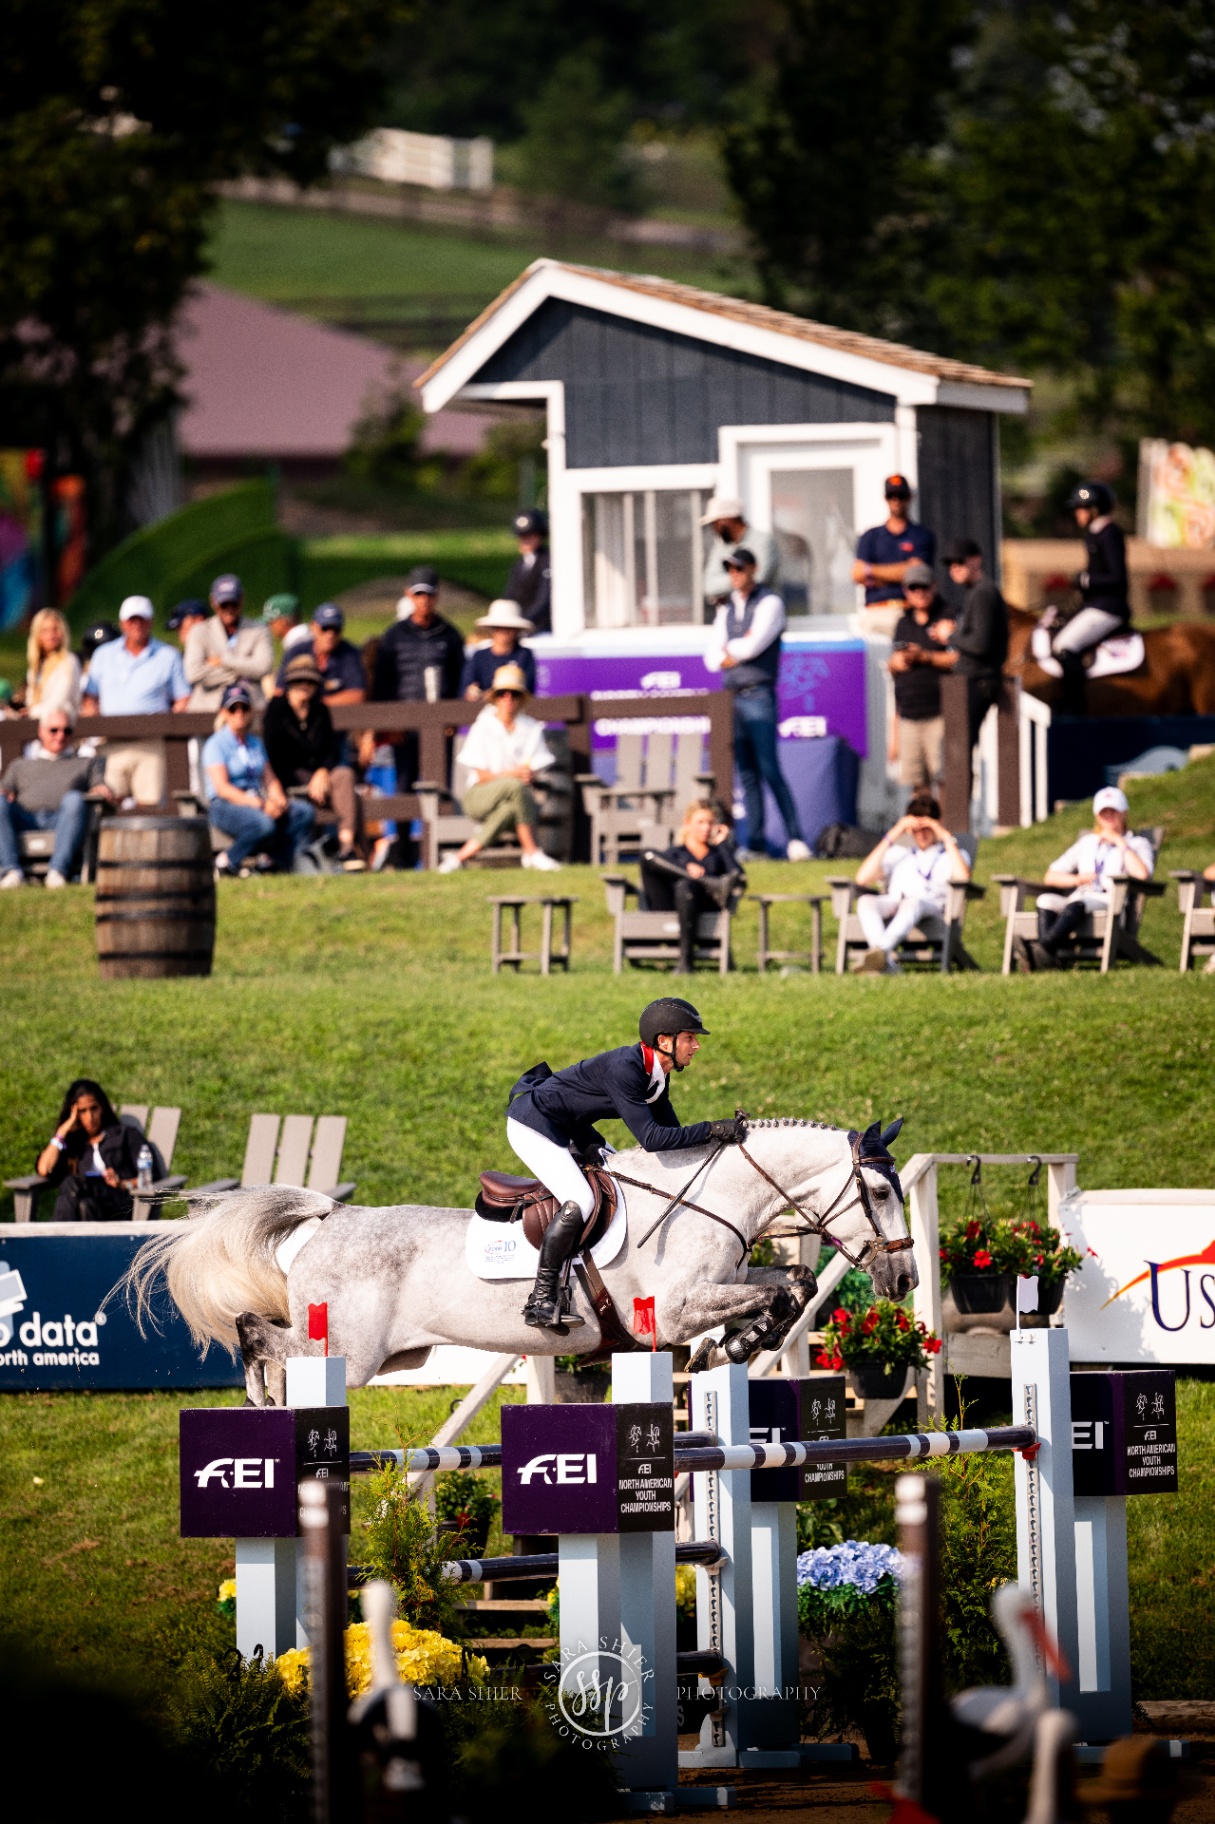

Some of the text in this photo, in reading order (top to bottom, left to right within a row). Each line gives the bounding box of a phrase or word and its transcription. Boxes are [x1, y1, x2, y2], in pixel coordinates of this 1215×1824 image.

[33, 1348, 100, 1366] america
[1127, 1443, 1176, 1456] NORTH AMERICAN
[1142, 1456, 1161, 1466] YOUTH
[193, 1458, 275, 1489] FEI
[517, 1453, 598, 1485] FEI
[637, 1464, 652, 1475] FEI
[1128, 1466, 1175, 1478] CHAMPIONSHIPS
[804, 1470, 845, 1483] CHAMPIONSHIPS
[618, 1477, 673, 1491] NORTH AMERICAN
[635, 1490, 656, 1501] YOUTH
[620, 1501, 672, 1514] CHAMPIONSHIPS
